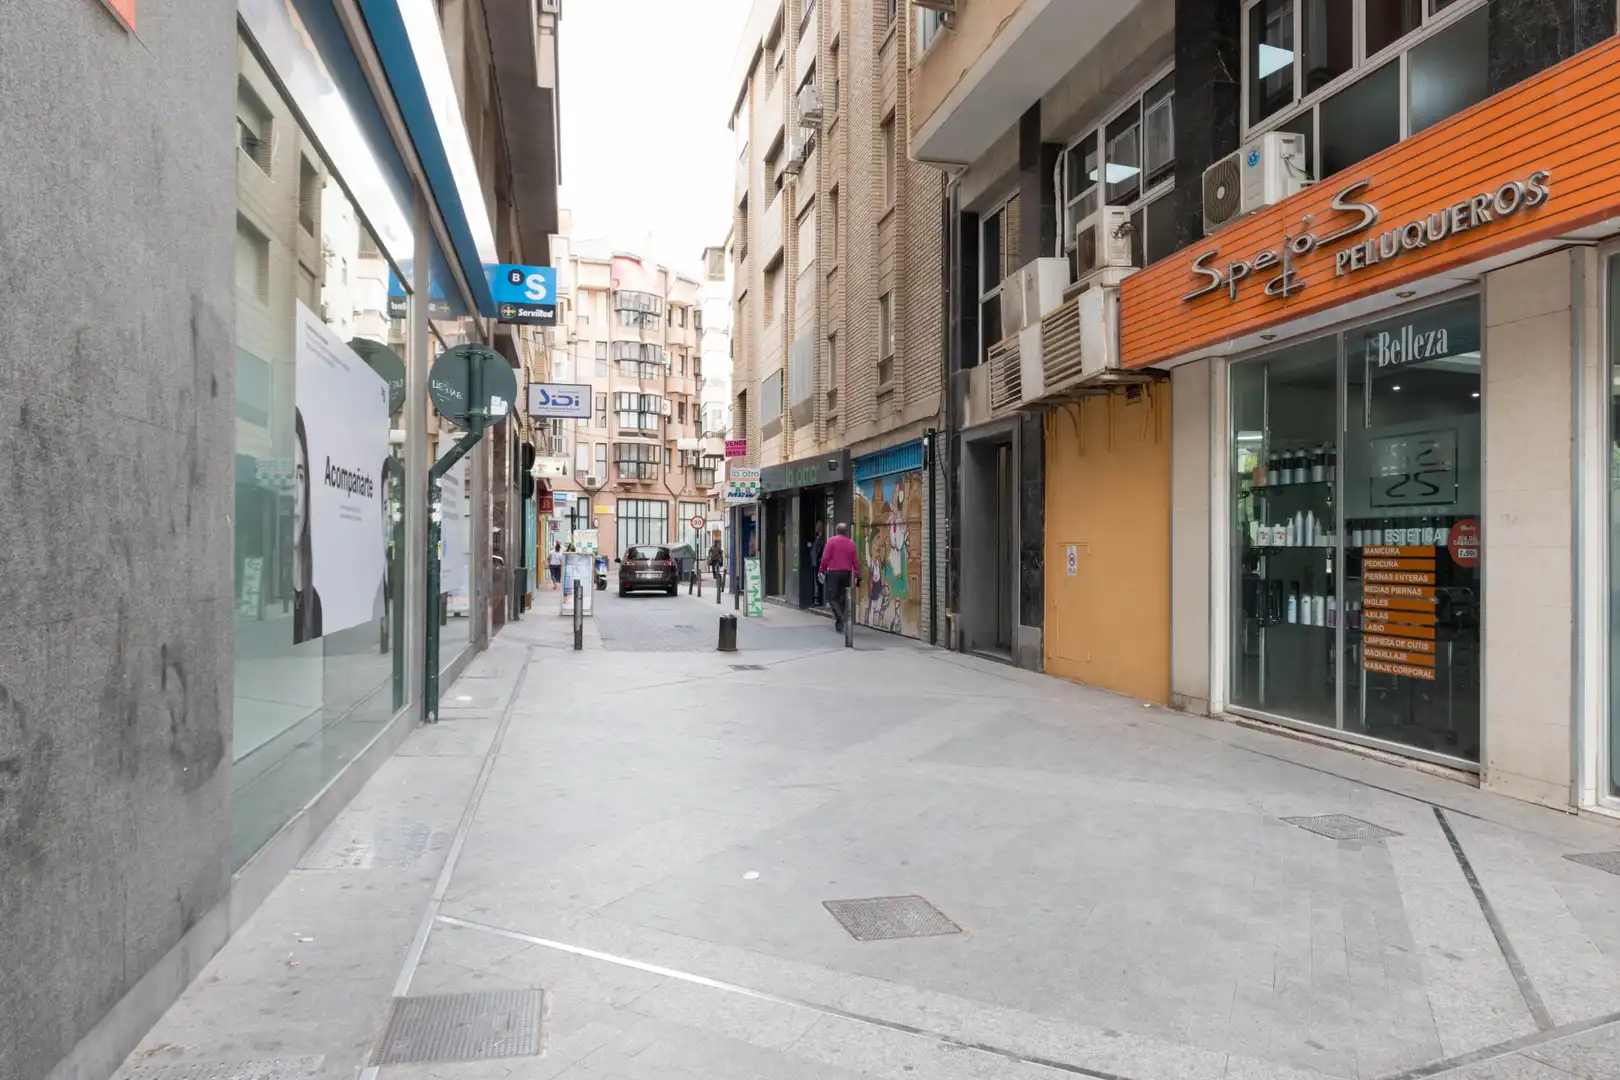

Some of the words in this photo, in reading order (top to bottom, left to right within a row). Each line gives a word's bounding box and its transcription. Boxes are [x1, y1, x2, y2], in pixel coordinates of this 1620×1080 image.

[1335, 170, 1549, 277] PELUQUEROS
[518, 308, 553, 318] ServiRed
[1378, 324, 1448, 367] Belleza
[324, 455, 373, 498] Acompañarte
[1364, 547, 1400, 555] MANICURA
[1364, 560, 1399, 568] PEDICURA
[1364, 573, 1394, 581] PIERNAS
[1395, 574, 1428, 582] ENTERAS
[1364, 585, 1389, 594] MEDIAS
[1391, 587, 1422, 595] PIERNAS
[1364, 598, 1388, 606] INGLES
[1364, 611, 1389, 619] AXILAS
[1364, 623, 1384, 632] LABIO
[1364, 636, 1394, 646] LIMPIEZA
[1407, 641, 1429, 650] CUTIS
[1364, 648, 1408, 660] MAQUILLAJE
[1364, 661, 1391, 672] MASAJE
[1393, 665, 1434, 678] CORPORAL
